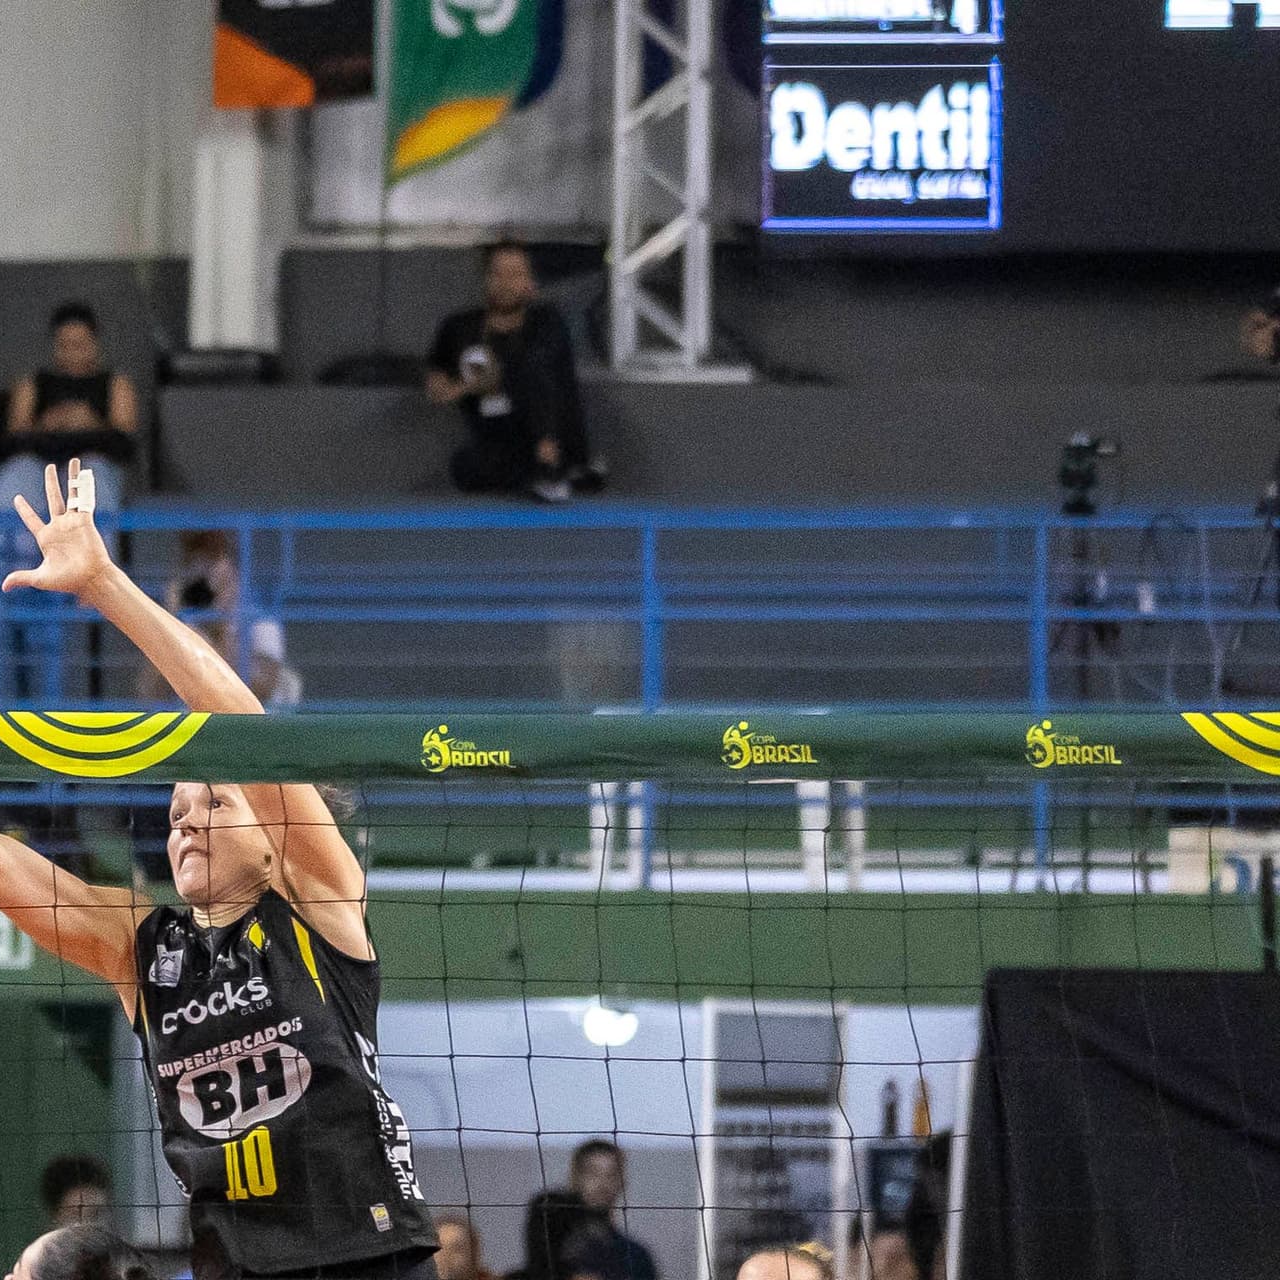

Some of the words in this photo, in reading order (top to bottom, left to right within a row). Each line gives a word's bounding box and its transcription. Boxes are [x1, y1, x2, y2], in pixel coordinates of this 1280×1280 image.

[770, 80, 990, 172] Dentil
[751, 735, 777, 744] COPA
[1054, 735, 1080, 745] COPA
[752, 744, 818, 764] BRASIL
[1055, 745, 1122, 765] BRASIL
[239, 999, 273, 1017] CLUB
[157, 1017, 303, 1078] SUPERMERCADOS
[191, 1046, 289, 1126] BH
[223, 1124, 277, 1201] 10
